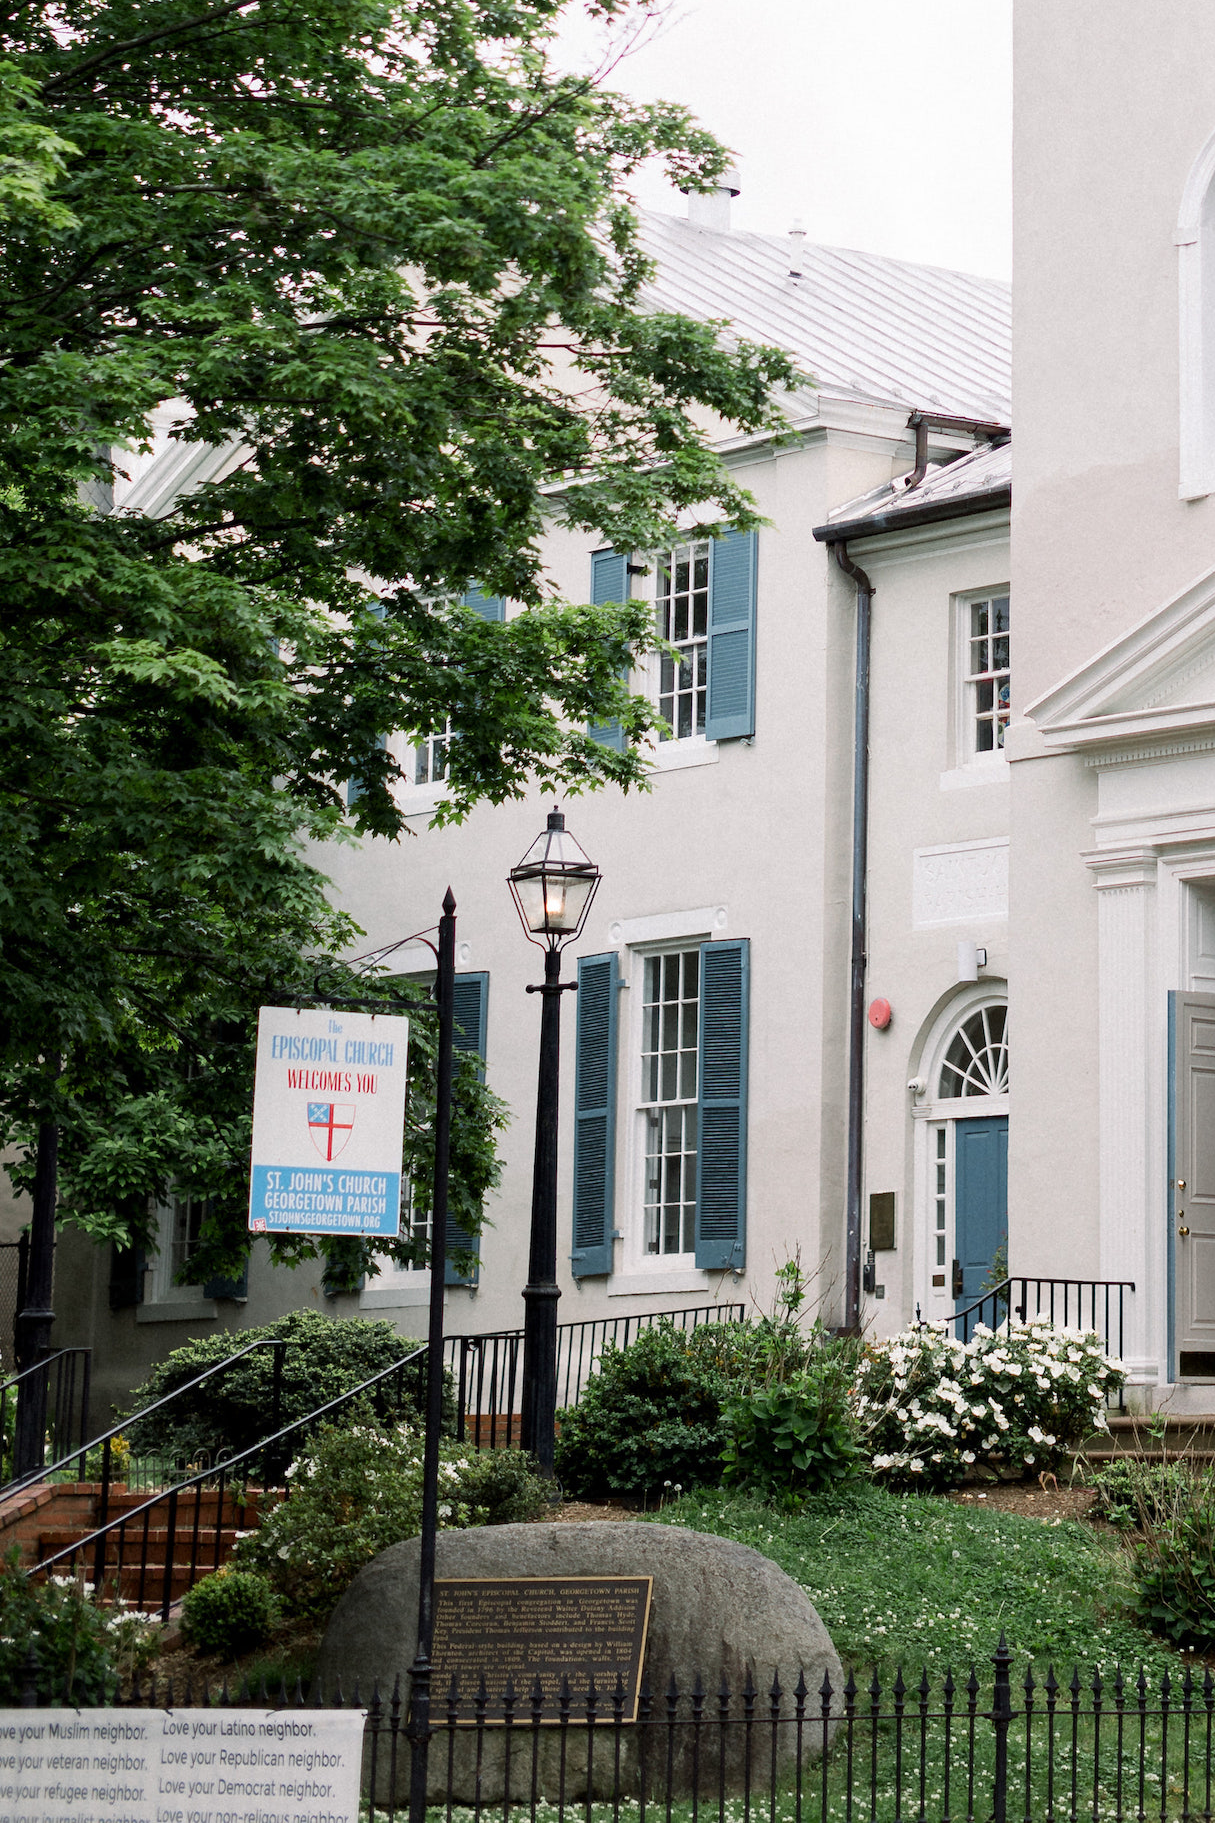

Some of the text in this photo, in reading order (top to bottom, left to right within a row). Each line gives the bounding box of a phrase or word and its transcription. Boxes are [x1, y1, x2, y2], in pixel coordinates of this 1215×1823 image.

[328, 1019, 343, 1034] The
[271, 1034, 394, 1067] EPISCOPAL CHURCH
[287, 1068, 378, 1095] WELCOMES YOU
[266, 1171, 387, 1196] ST. JOHN'S CHURCH
[264, 1191, 387, 1214] GEORGETOWN PARISH
[268, 1210, 381, 1229] STJOHNSGEORGETOWN.ORG
[19, 1725, 45, 1744] your
[48, 1722, 90, 1740] Muslim
[93, 1722, 148, 1744] neighbor.
[162, 1719, 317, 1741] Love your Latino neighbor.
[18, 1755, 44, 1774] your
[46, 1753, 90, 1770] veteran
[92, 1752, 148, 1775] neighbor.
[160, 1748, 345, 1772] Love your Republican neighbor.
[15, 1785, 41, 1803] your
[44, 1782, 88, 1804] refugee
[91, 1783, 148, 1806] neighbor.
[158, 1778, 336, 1802] Love your Democrat neighbor.
[156, 1807, 183, 1823] Love
